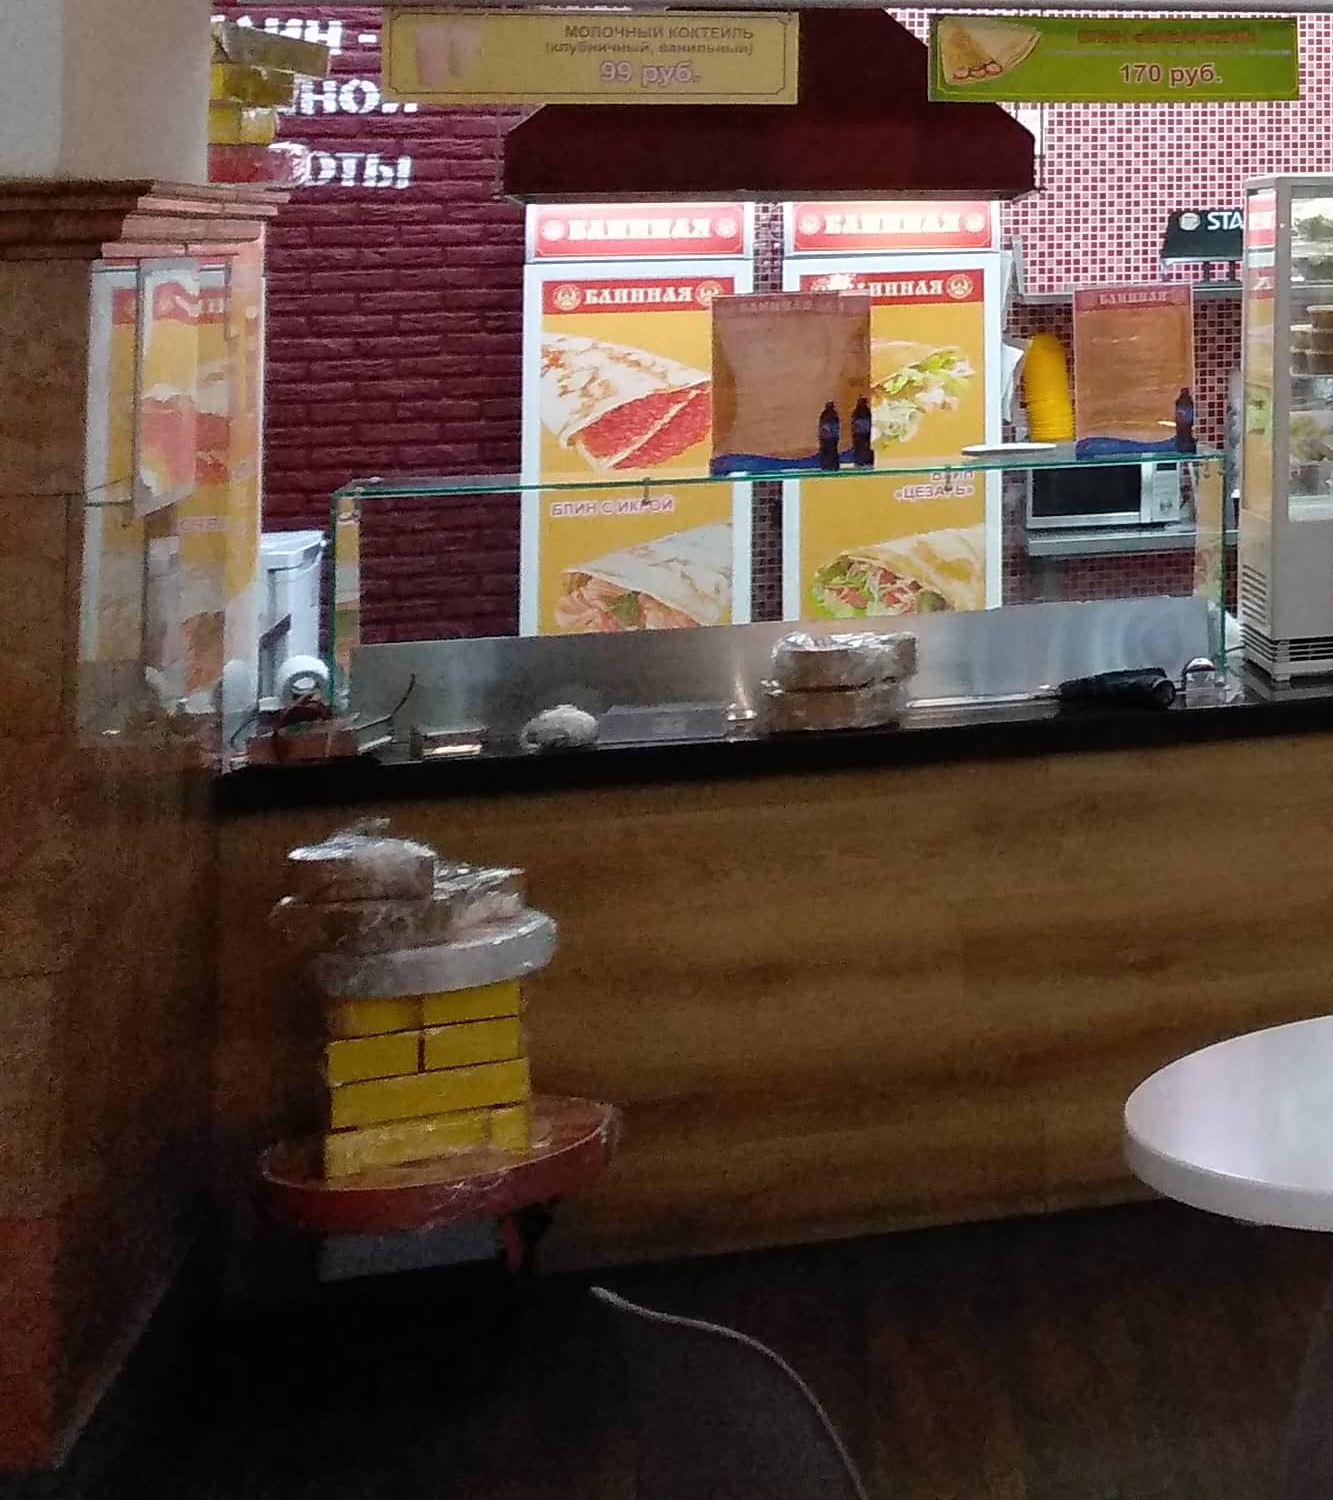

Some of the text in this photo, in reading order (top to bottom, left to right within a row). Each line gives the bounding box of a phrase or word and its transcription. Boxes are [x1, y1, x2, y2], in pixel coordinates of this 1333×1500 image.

[565, 24, 754, 40] МОЛОЧНЫЙ КОКТЕЙЛЬ
[600, 60, 701, 88] 99 руб.
[1119, 62, 1223, 88] 170 руб.
[567, 217, 713, 241] БЛИННАЯ
[824, 212, 962, 235] БЛИННАЯ
[1207, 211, 1245, 230] STA
[584, 284, 694, 305] БЛИННАЯ
[895, 484, 976, 500] «ЦЕЗАЬ»
[551, 502, 598, 517] БЛИН
